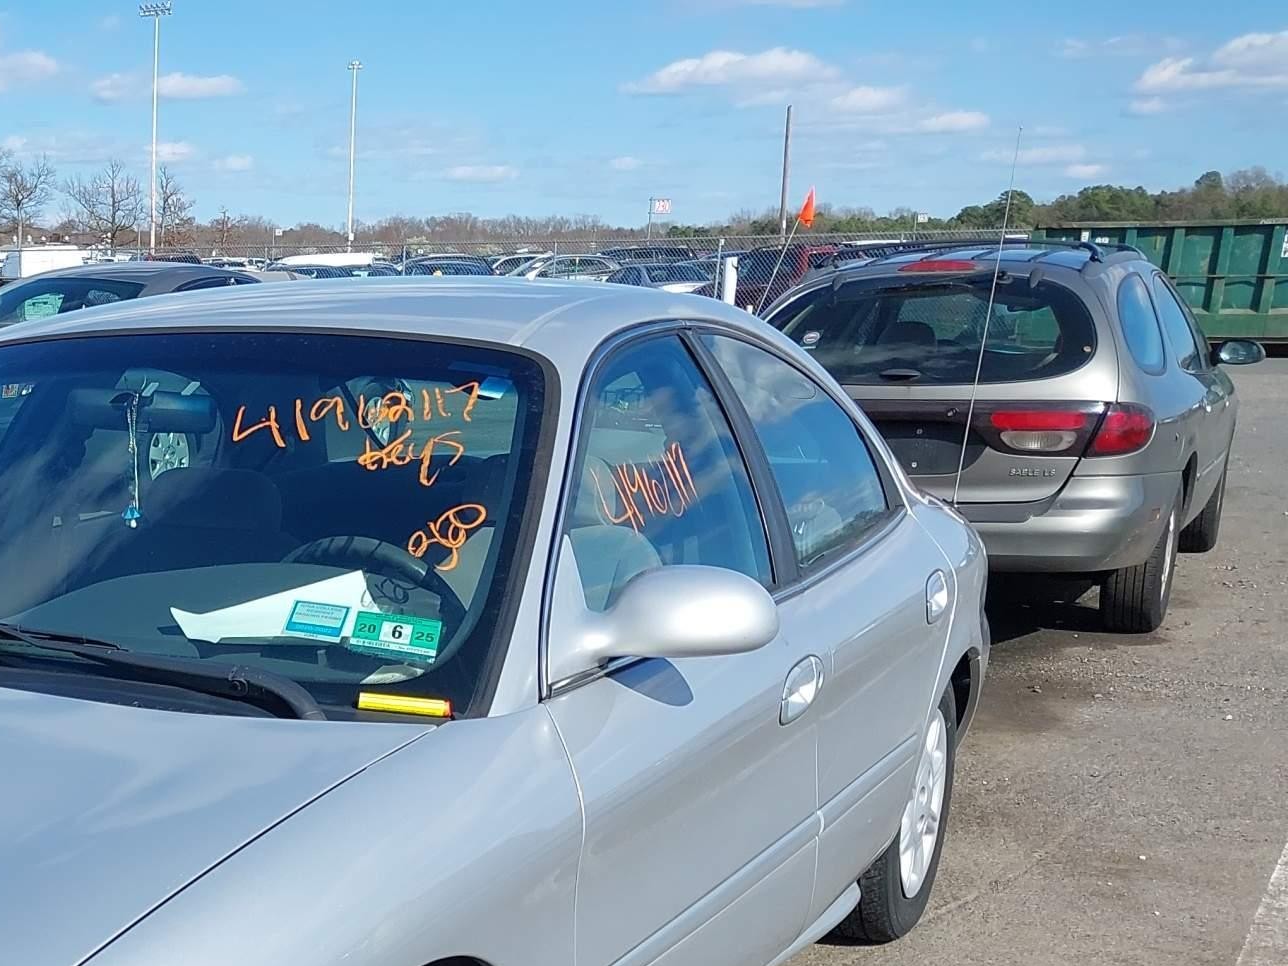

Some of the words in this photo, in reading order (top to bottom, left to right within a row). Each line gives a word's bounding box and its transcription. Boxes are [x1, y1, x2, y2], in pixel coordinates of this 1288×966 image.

[358, 622, 377, 633] 20
[392, 624, 404, 639] 6
[415, 631, 435, 642] 25
